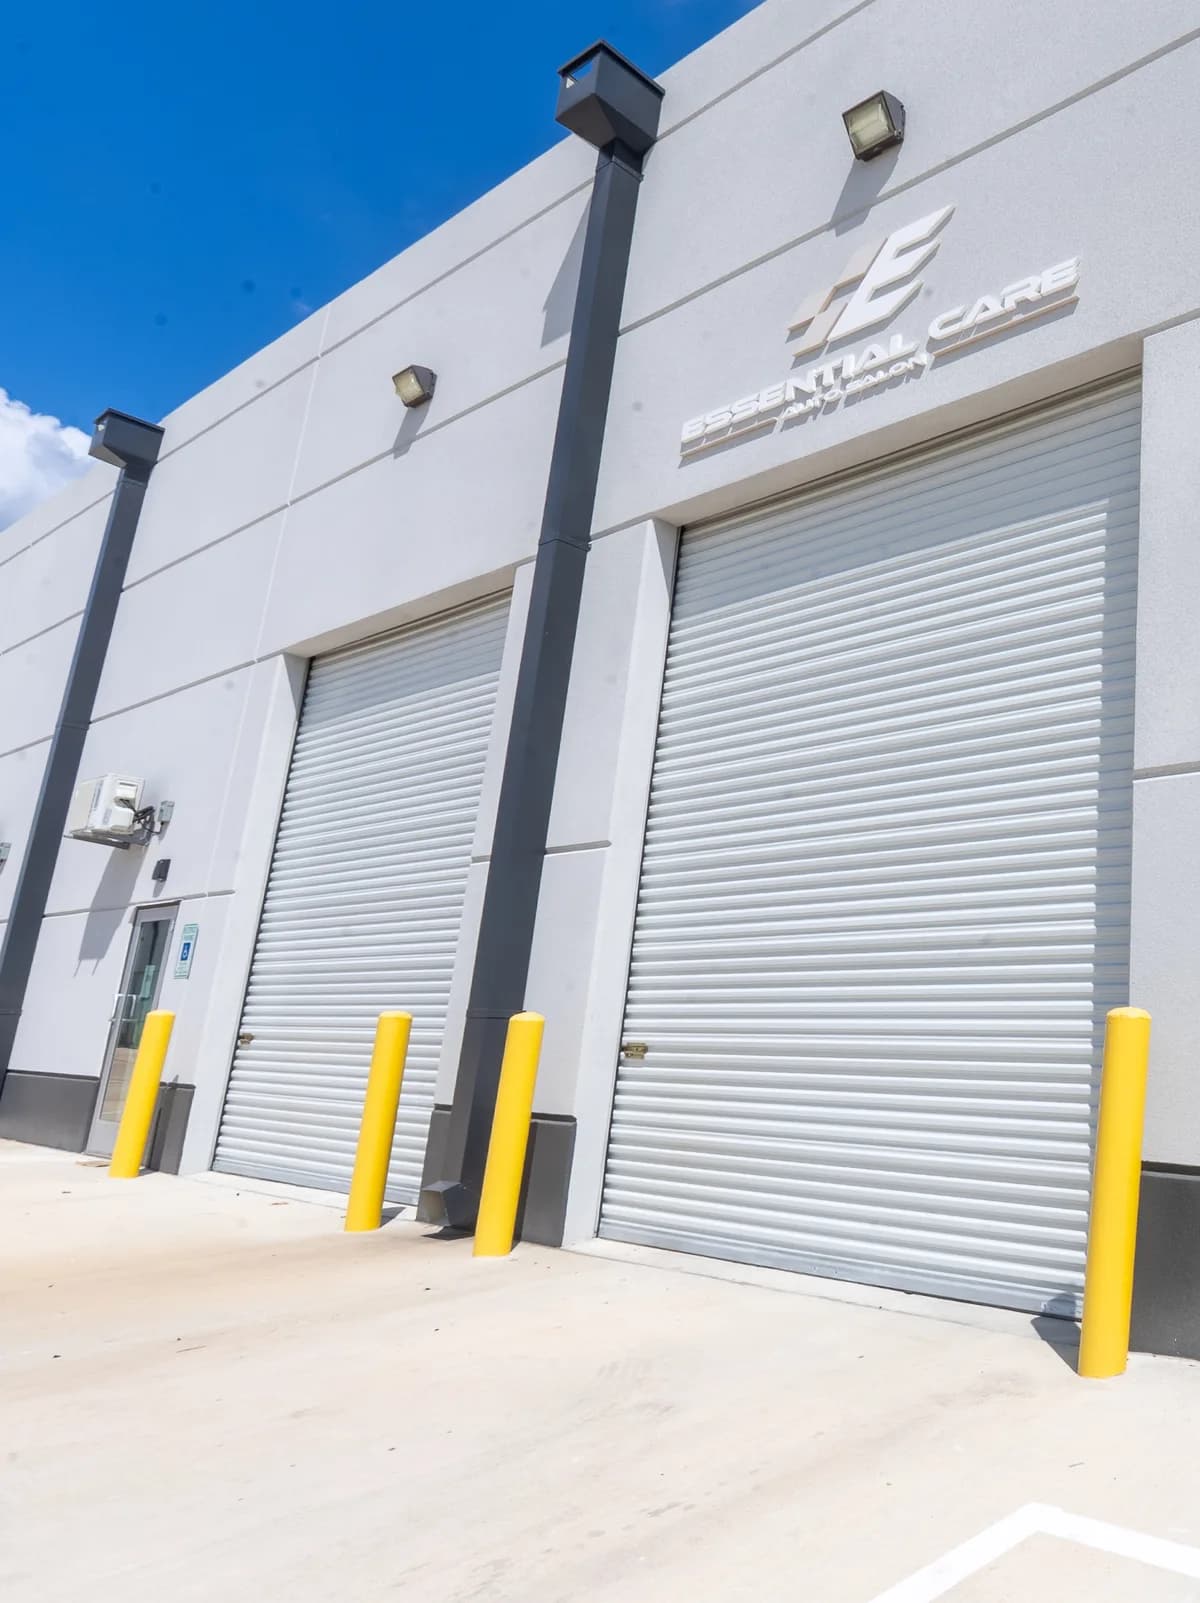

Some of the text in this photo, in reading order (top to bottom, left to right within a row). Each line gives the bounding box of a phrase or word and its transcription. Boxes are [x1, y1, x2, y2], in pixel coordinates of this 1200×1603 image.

[681, 255, 1081, 443] ESSENTIAL CARE
[782, 352, 929, 420] AUTO SALON
